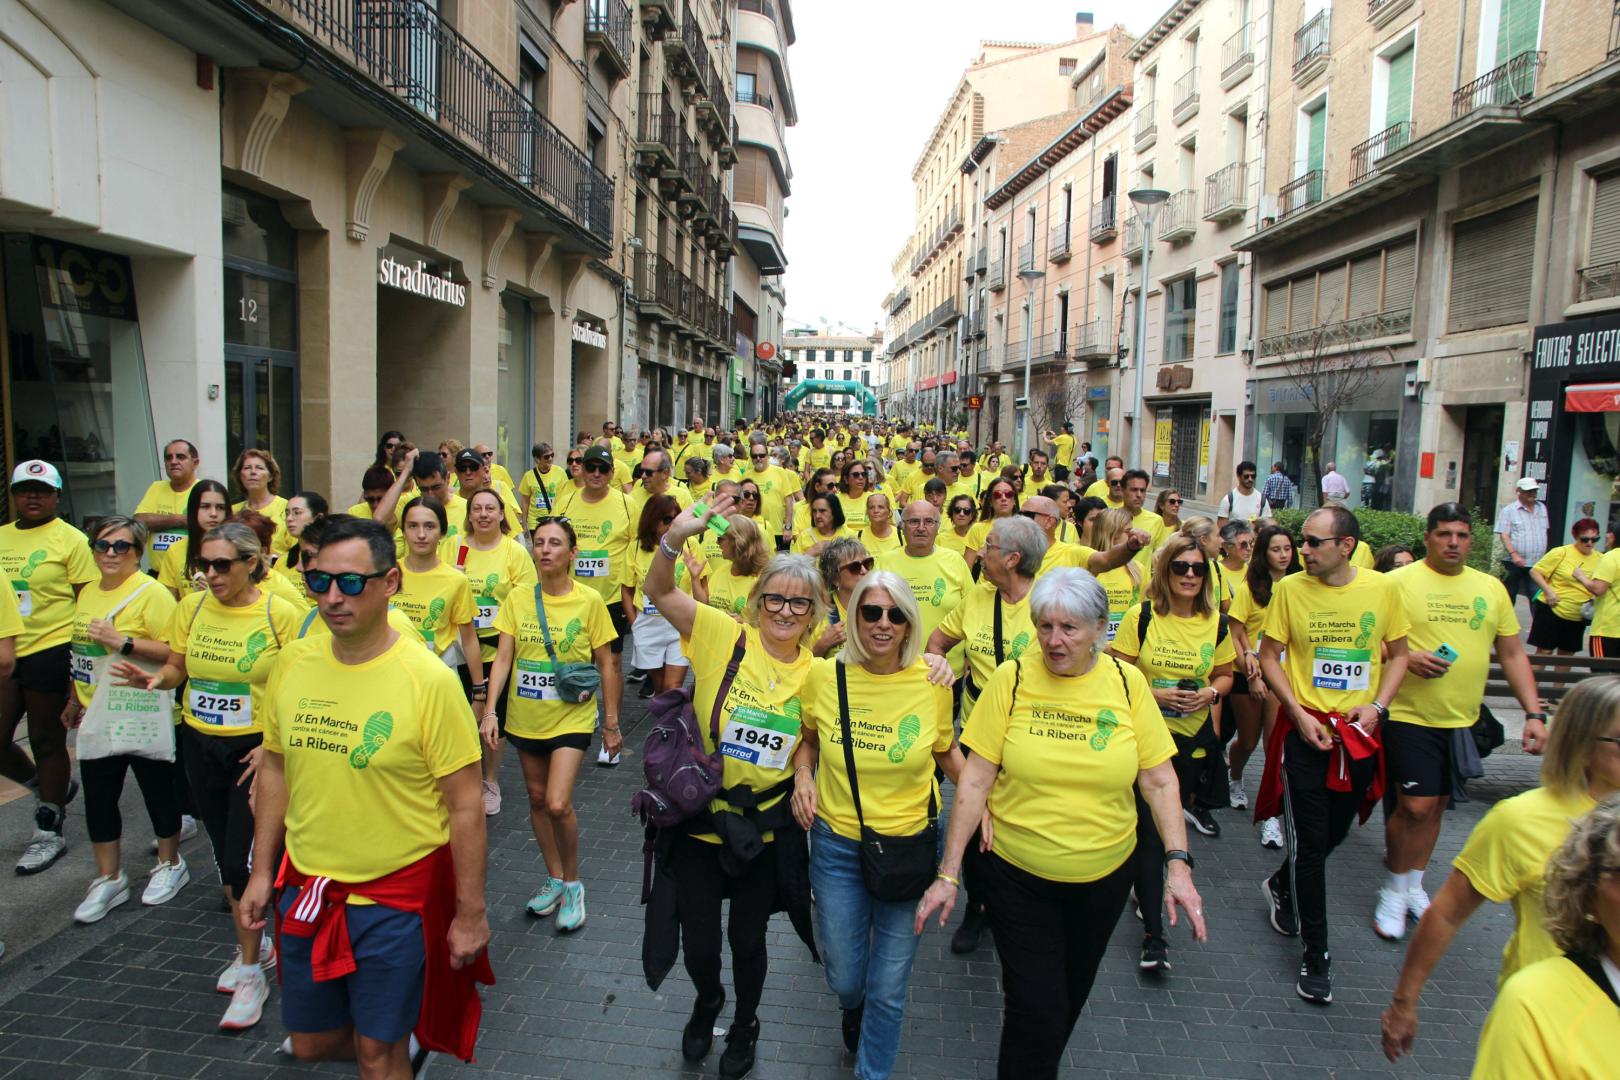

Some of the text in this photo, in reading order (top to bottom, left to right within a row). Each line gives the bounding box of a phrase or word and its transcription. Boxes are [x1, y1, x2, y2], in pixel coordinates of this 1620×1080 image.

[379, 256, 466, 308] stradivarius
[239, 297, 258, 323] 12
[572, 320, 608, 350] stradivarius
[1535, 335, 1572, 369] FRUTAS
[578, 560, 604, 568] 0176
[402, 602, 426, 610] Marcha
[202, 636, 212, 644] En
[214, 638, 243, 648] Marcha
[520, 634, 528, 642] La
[190, 648, 236, 664] La Ribera
[970, 642, 996, 656] La Rib
[1172, 648, 1197, 657] Marcha
[1152, 658, 1194, 670] La Ribera
[1322, 662, 1362, 676] 0610
[522, 674, 556, 687] 2135
[730, 686, 740, 695] IX
[739, 690, 751, 701] En
[108, 702, 160, 712] La Ribera
[197, 696, 242, 712] 2725
[294, 713, 358, 732] IX En Marcha
[1032, 710, 1092, 724] IX En Marcha
[858, 720, 893, 734] Marcha
[1029, 726, 1087, 741] La Ribera
[289, 735, 348, 754] La Ribera
[734, 728, 784, 751] 1943
[830, 733, 843, 744] La
[722, 744, 753, 758] Larrad
